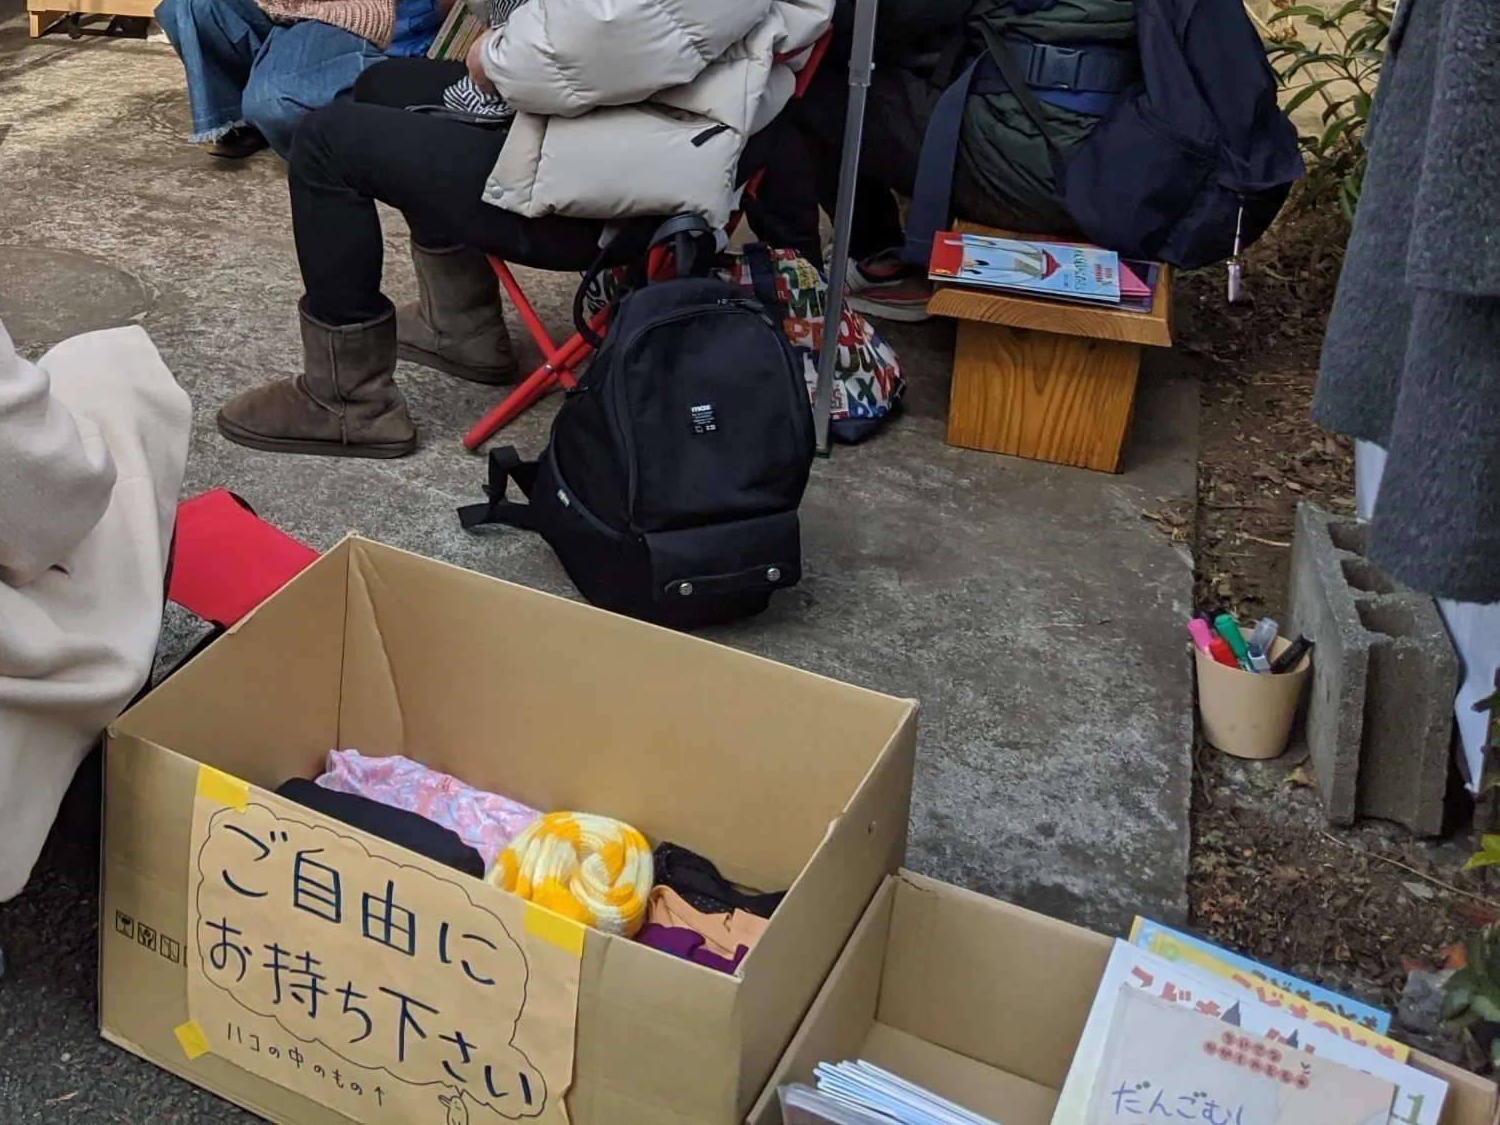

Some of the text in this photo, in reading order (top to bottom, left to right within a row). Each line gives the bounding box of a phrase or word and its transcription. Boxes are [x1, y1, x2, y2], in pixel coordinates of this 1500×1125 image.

[222, 824, 498, 986] ご自由に
[205, 916, 532, 1106] お持ち下さい
[228, 1022, 364, 1096] ハコの中のもの
